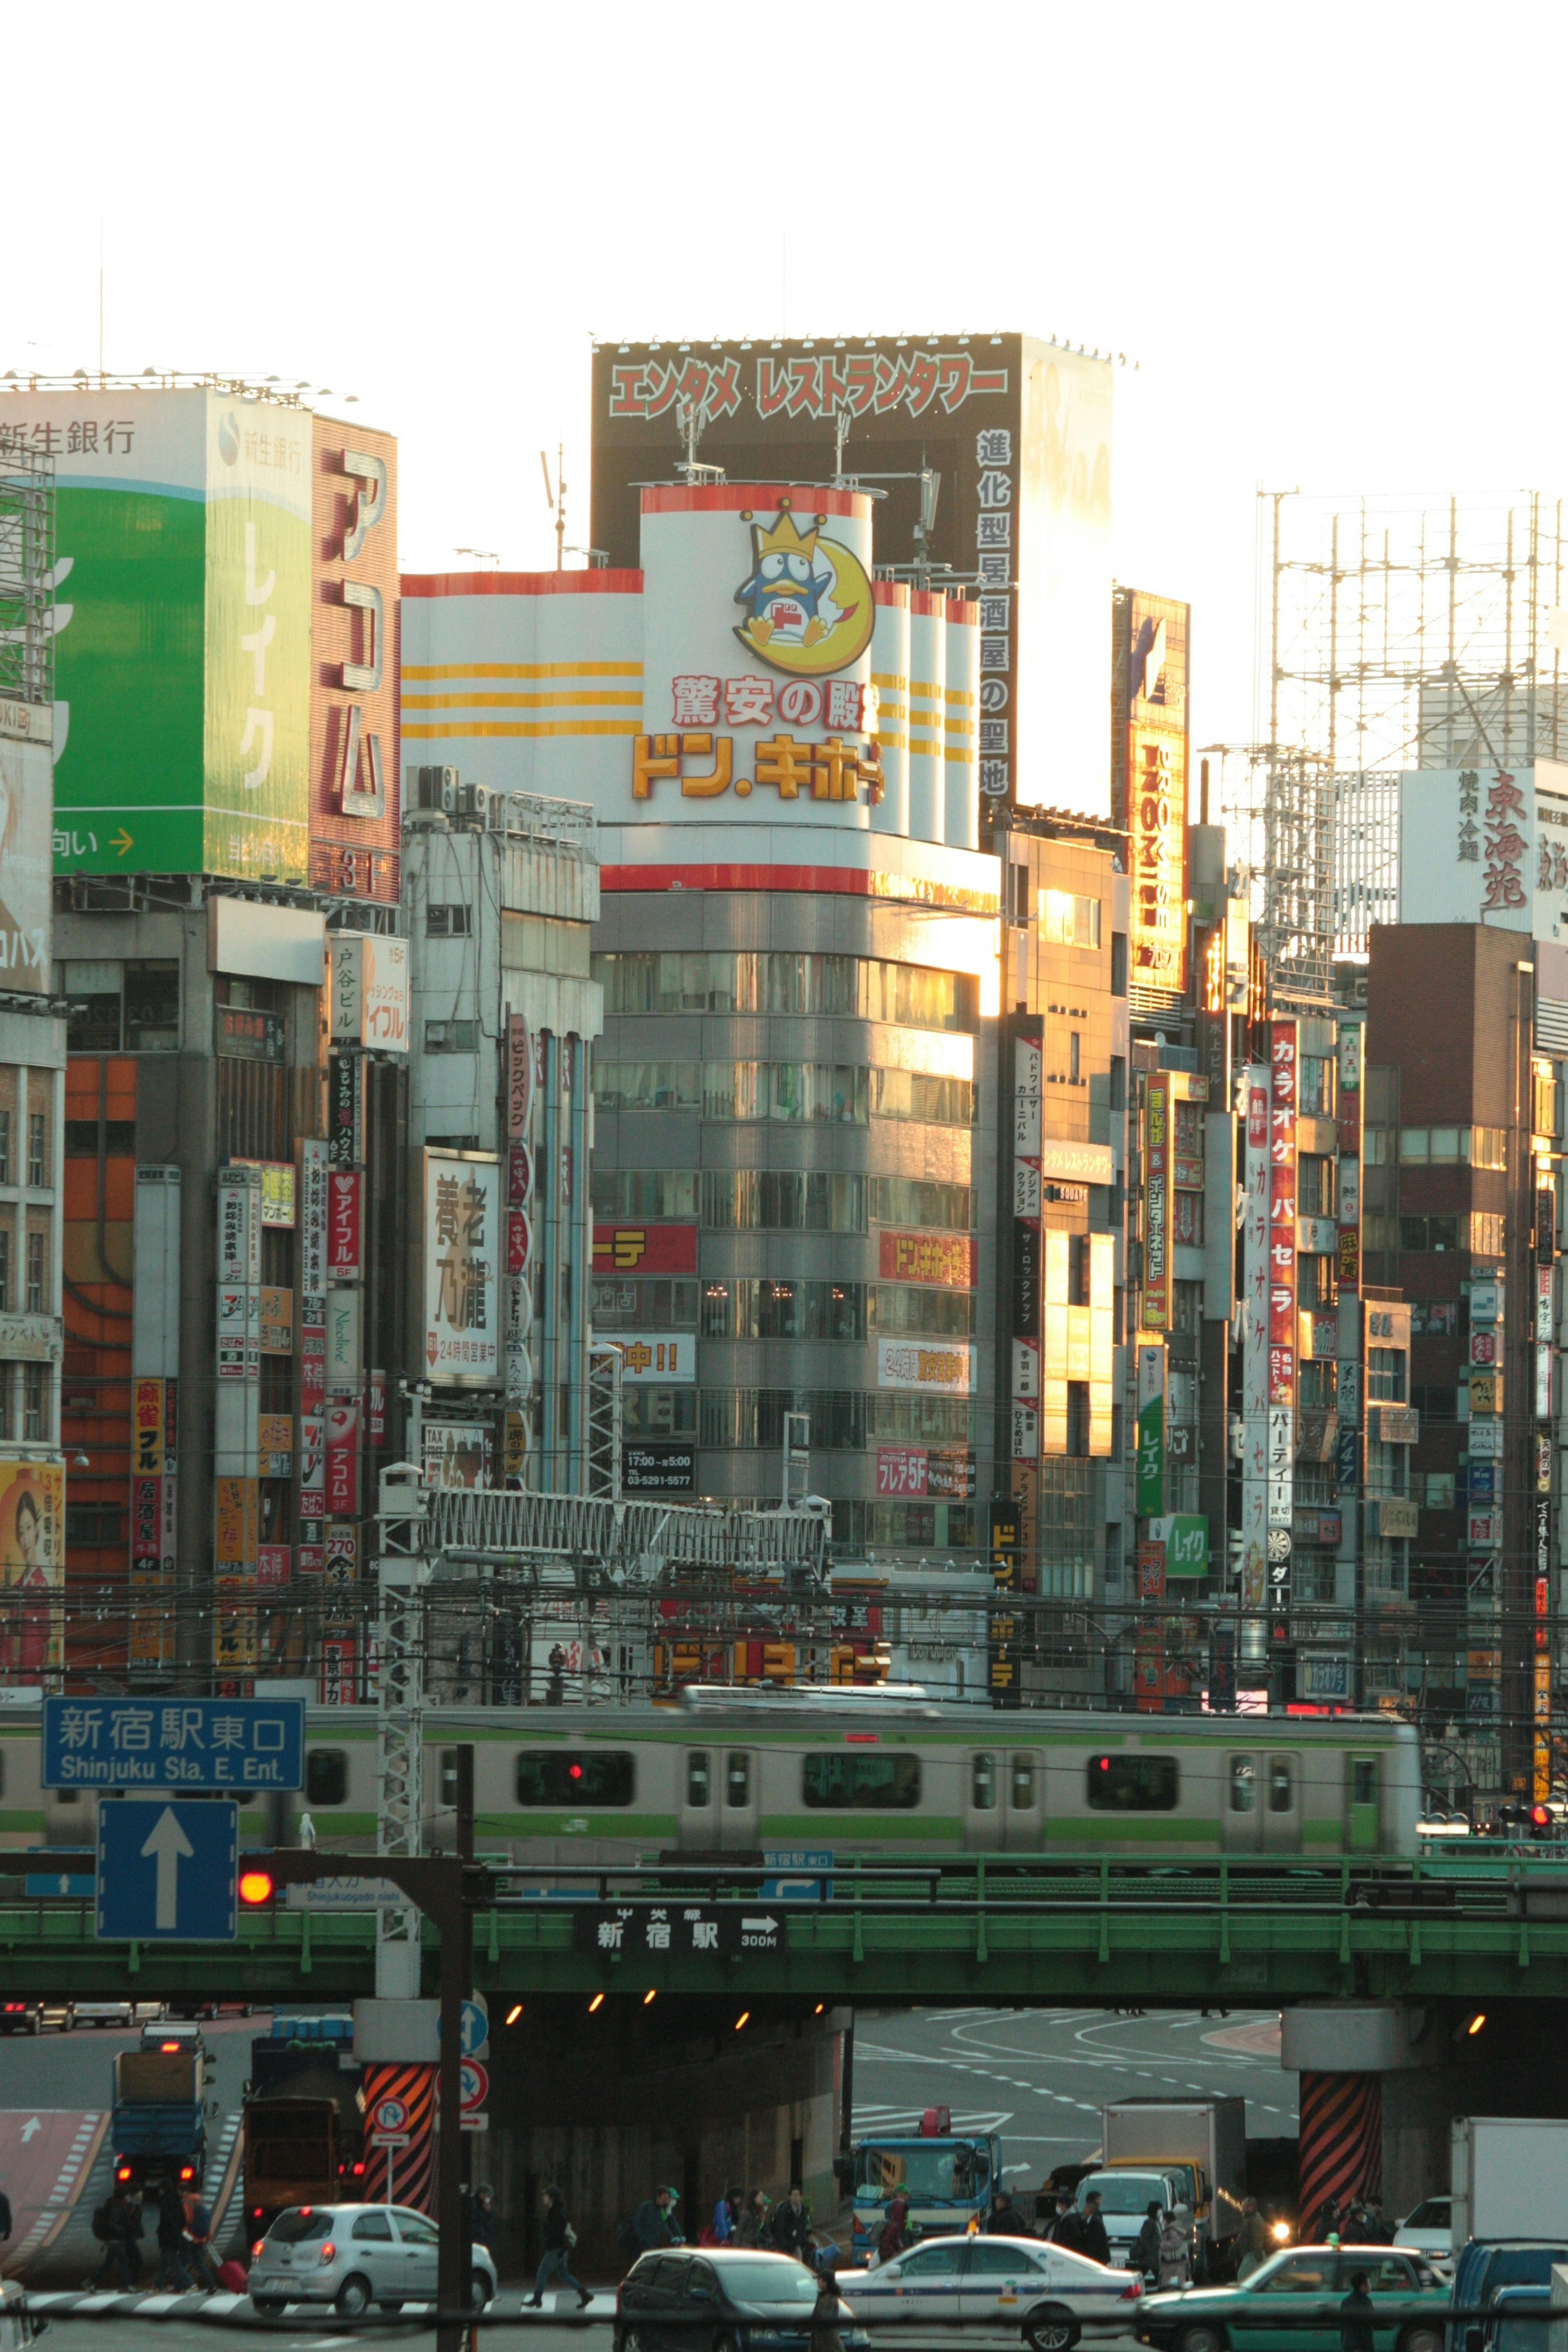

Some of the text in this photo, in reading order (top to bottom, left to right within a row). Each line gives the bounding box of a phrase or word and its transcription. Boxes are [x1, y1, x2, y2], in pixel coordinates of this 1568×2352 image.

[609, 351, 1009, 421] エンタメ レストランタワー
[0, 420, 136, 456] 新生銀行
[244, 429, 302, 475] 新生銀行
[339, 448, 387, 817] アコム
[976, 428, 1013, 796] 進化型居酒屋の聖地
[240, 521, 276, 790] レイク
[0, 703, 30, 736] KI町
[1156, 742, 1171, 929] PROMISE
[1480, 769, 1529, 909] 東海苑
[367, 1002, 404, 1040] イフル
[1029, 1052, 1039, 1120] バドワイザー
[1017, 1085, 1027, 1142] カーニバル
[1017, 1171, 1025, 1214] クッション
[1028, 1171, 1037, 1198] アジア
[1271, 1040, 1295, 1312] カラオケパセラ
[336, 1195, 353, 1263] アイフル
[1148, 1174, 1165, 1281] インターネット
[336, 1267, 352, 1277] 5F
[1021, 1232, 1033, 1324] ザ・ロックアップ
[221, 1337, 243, 1347] たばこ
[440, 1340, 496, 1363] 24時間営業中
[1282, 1353, 1292, 1375] 名物
[427, 1430, 443, 1443] TAX
[427, 1446, 444, 1460] FREE
[1014, 1411, 1023, 1457] ひとめぼれ
[1142, 1430, 1159, 1480] レイク
[1271, 1412, 1290, 1499] パーティー
[1341, 1430, 1354, 1482] 747
[332, 1448, 349, 1497] アコム
[627, 1476, 690, 1486] 03-5291-5577
[879, 1463, 908, 1492] フレア
[301, 1495, 323, 1514] たばこ
[326, 1539, 355, 1555] 270
[1174, 1529, 1205, 1562] レイク
[991, 1525, 1015, 1688] ドン.ホーテ
[59, 1706, 285, 1751] 新宿駅東口
[60, 1756, 284, 1784] Shinjuku Sta. E. Ent.
[306, 1891, 401, 1904] Shinjukuogado nishi
[597, 1921, 718, 1949] 新宿駅
[740, 1934, 777, 1948] 300M
